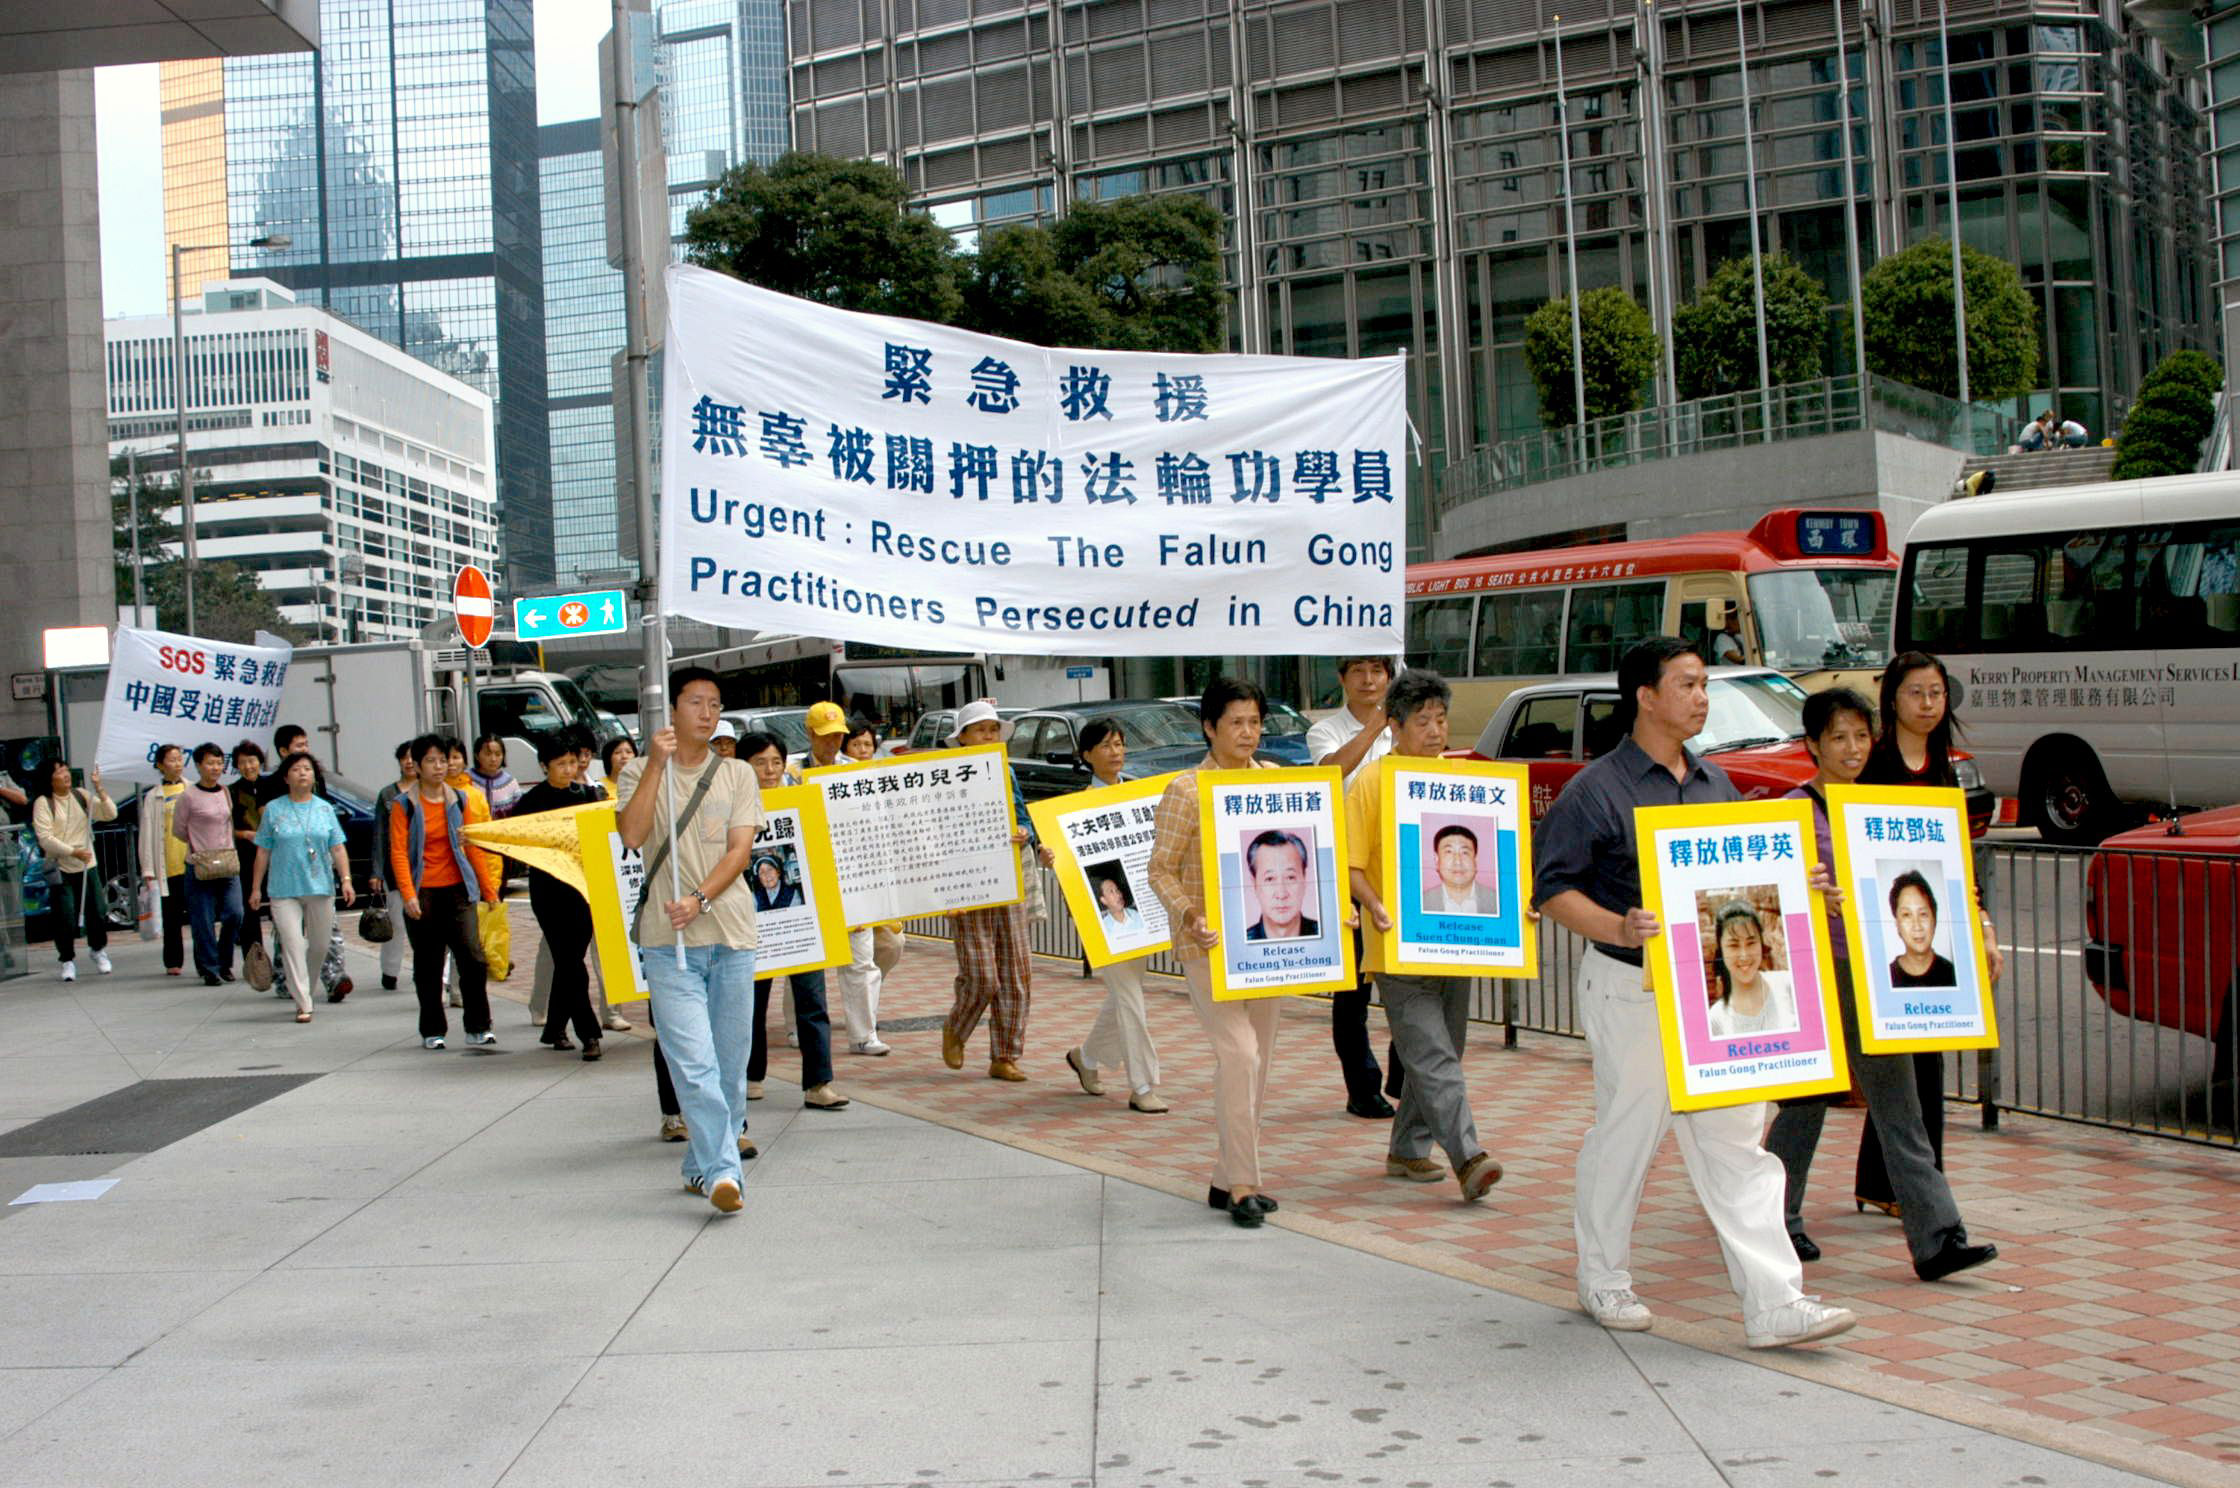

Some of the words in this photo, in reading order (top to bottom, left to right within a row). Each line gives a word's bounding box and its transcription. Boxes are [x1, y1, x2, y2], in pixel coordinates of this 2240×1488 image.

[882, 341, 1210, 423] 緊急救援
[691, 395, 1394, 506] 無辜被關押的法輪功學員
[872, 520, 1012, 566] Rescue
[1048, 535, 1124, 569] The
[1160, 534, 1266, 566] Falun
[1308, 533, 1392, 574] Gong
[690, 556, 946, 626] Practitioners
[977, 596, 1198, 630] Persecuted
[1229, 596, 1261, 627] in
[1293, 595, 1392, 628] China
[159, 645, 205, 675] SOS
[1970, 667, 2009, 685] KERRY
[2012, 666, 2072, 684] PROPERTY
[2075, 665, 2163, 683] MANAGEMENT
[2167, 663, 2230, 681] SERVICES
[1970, 687, 2175, 708] 嘉里物業管理服務有限公司
[1534, 800, 1553, 816] TAX
[1438, 921, 1483, 932] Release
[1263, 946, 1305, 957] Release
[1904, 1003, 1952, 1015] Release
[1728, 1040, 1790, 1057] Release
[1699, 1067, 1727, 1079] Falun
[1729, 1064, 1756, 1075] Gong
[1759, 1057, 1818, 1071] Practitioner
